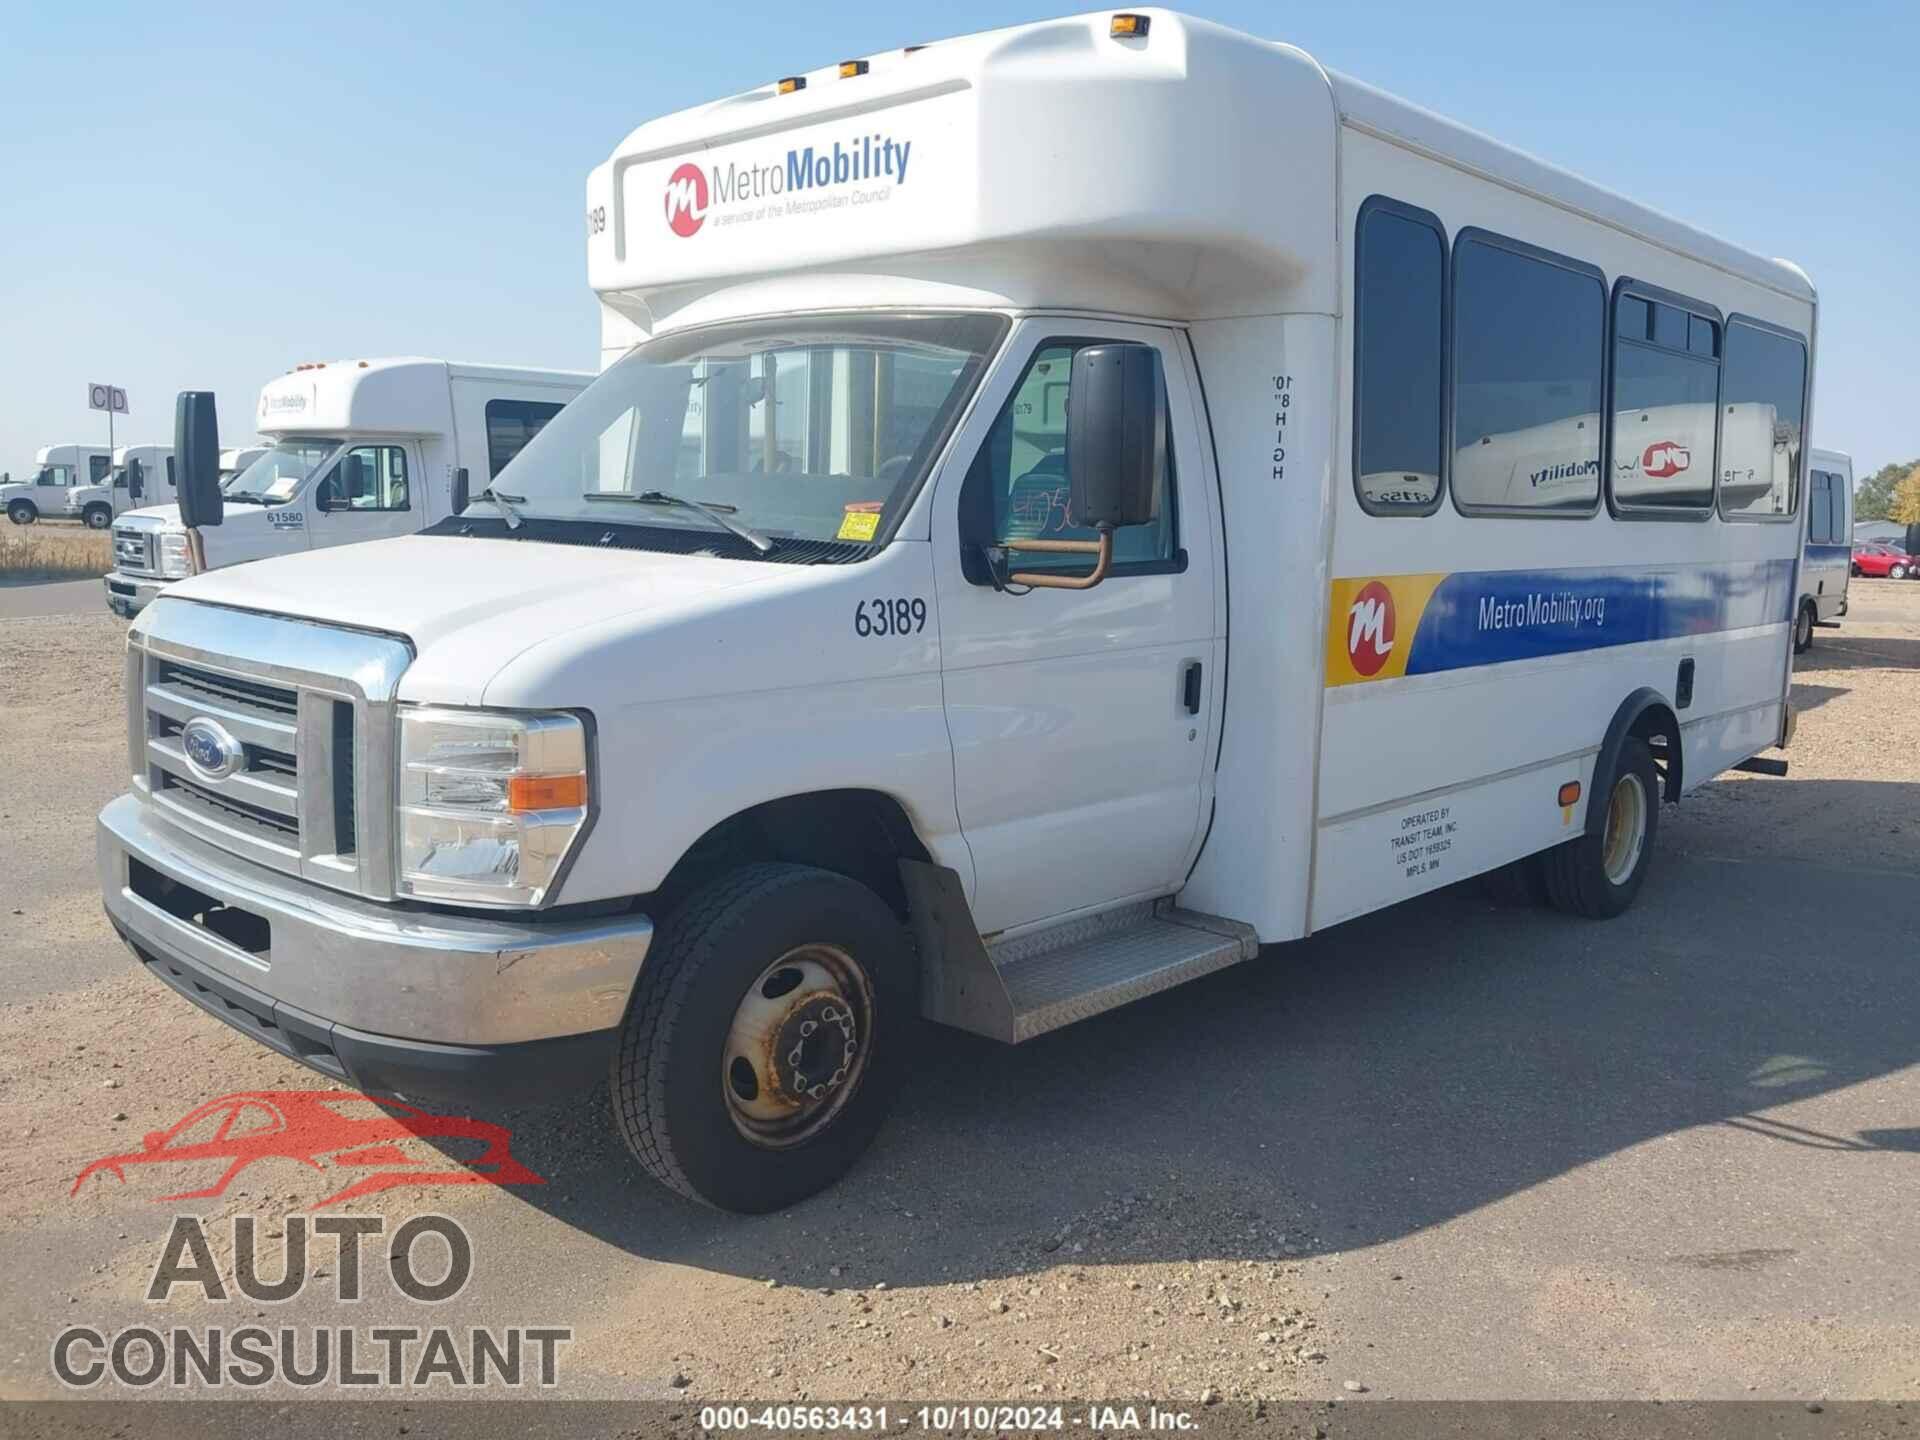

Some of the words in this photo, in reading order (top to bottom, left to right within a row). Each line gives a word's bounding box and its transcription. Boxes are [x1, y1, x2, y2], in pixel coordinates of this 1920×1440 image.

[712, 133, 911, 206] MetroMobility
[721, 209, 754, 226] service
[755, 205, 767, 221] of
[767, 203, 784, 218] the
[785, 194, 849, 215] Metropolitan
[851, 185, 891, 205] Council
[92, 386, 106, 408] C
[113, 390, 125, 410] D
[267, 511, 303, 522] 61580
[855, 598, 926, 637] 63189
[1478, 591, 1605, 631] MetroMobility.org
[1400, 810, 1439, 830] OPERATED
[1440, 807, 1450, 819] BY
[1391, 831, 1420, 850] TRANSIT
[1396, 852, 1407, 865] US
[1408, 846, 1424, 861] DOT
